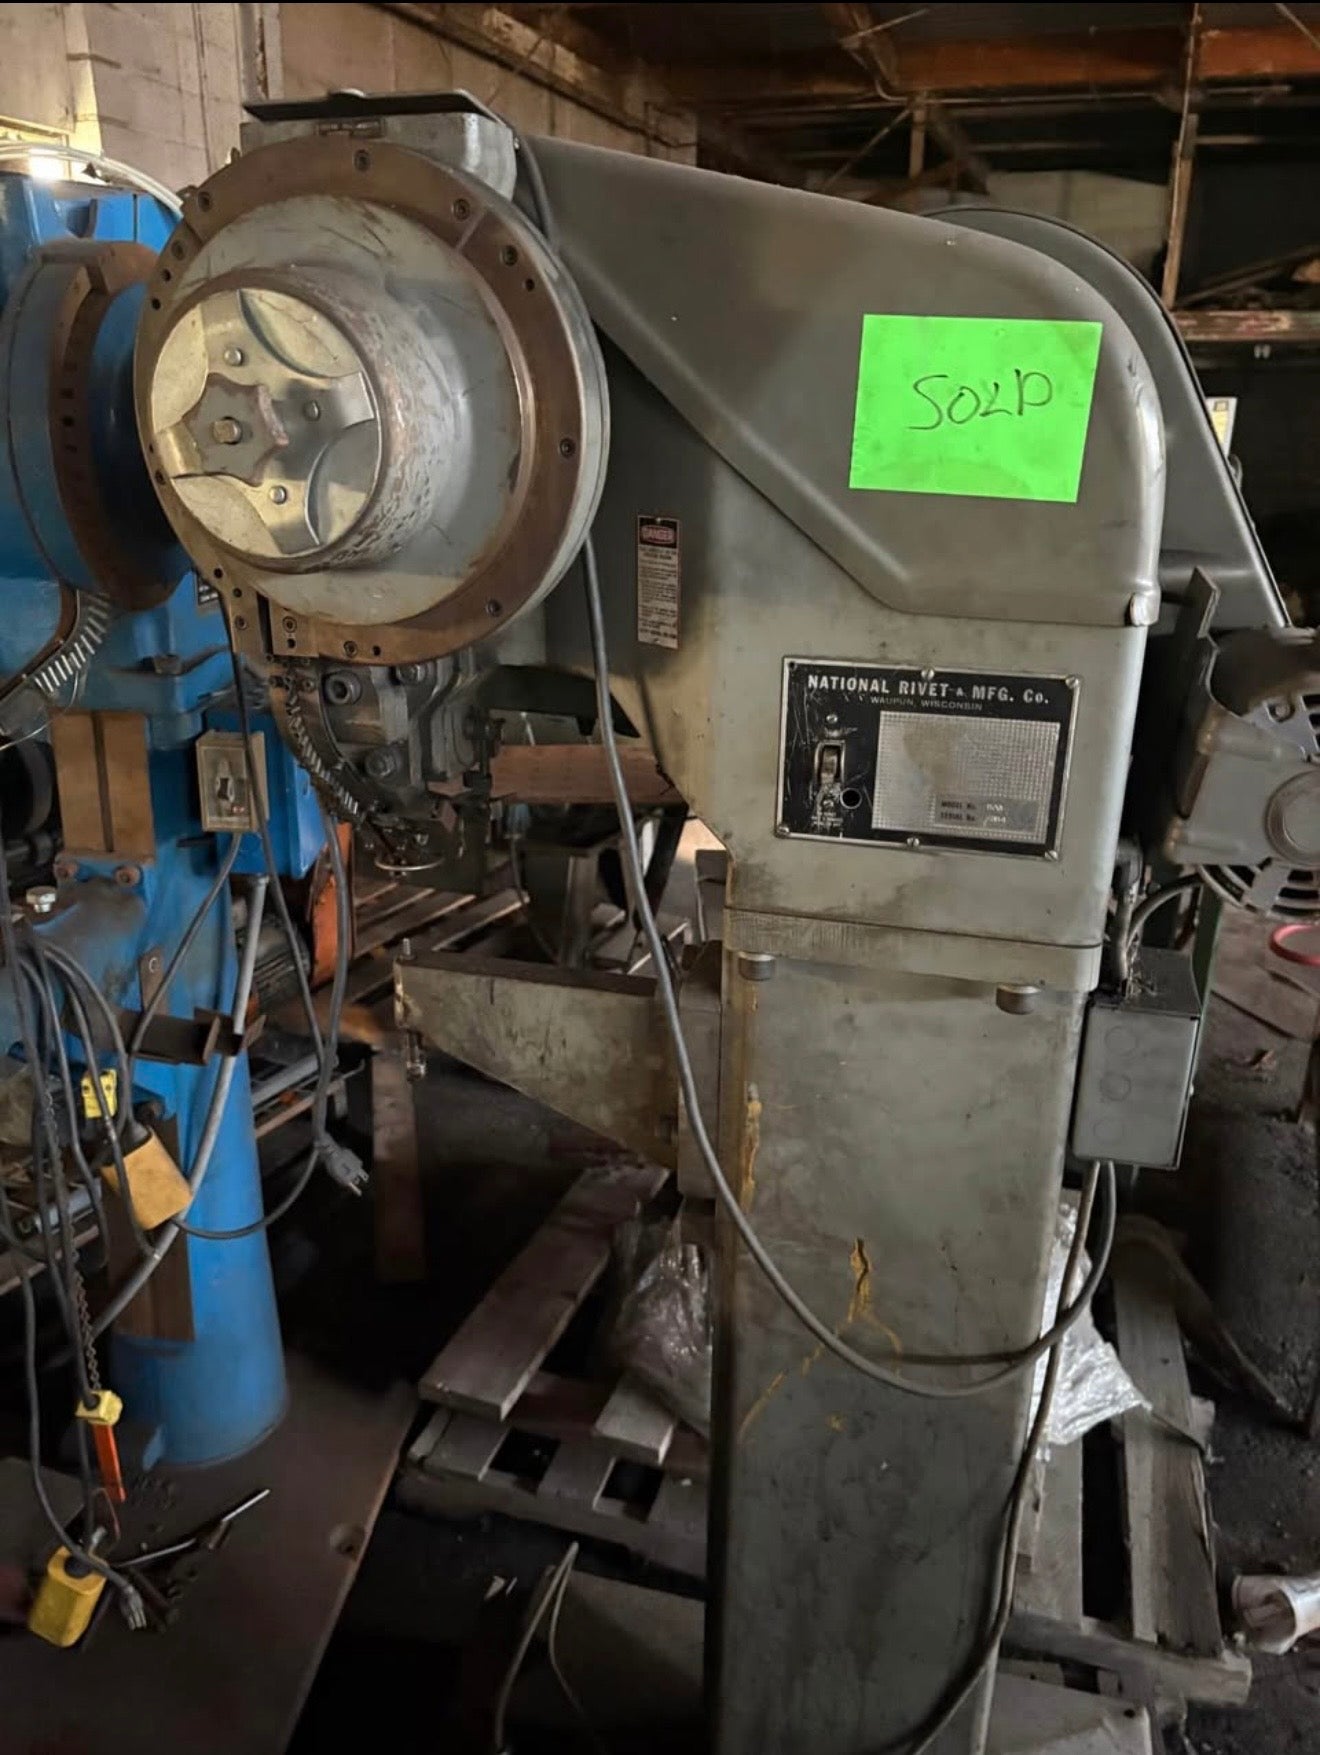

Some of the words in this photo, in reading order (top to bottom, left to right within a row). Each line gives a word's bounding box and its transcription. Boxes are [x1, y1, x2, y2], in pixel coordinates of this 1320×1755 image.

[907, 368, 1053, 430] SOLD
[807, 674, 890, 694] NATIONAL
[899, 680, 949, 697] RIVET
[972, 684, 1014, 702] MFG.
[1022, 688, 1049, 705] Co.
[921, 698, 983, 711] WISCONSIN
